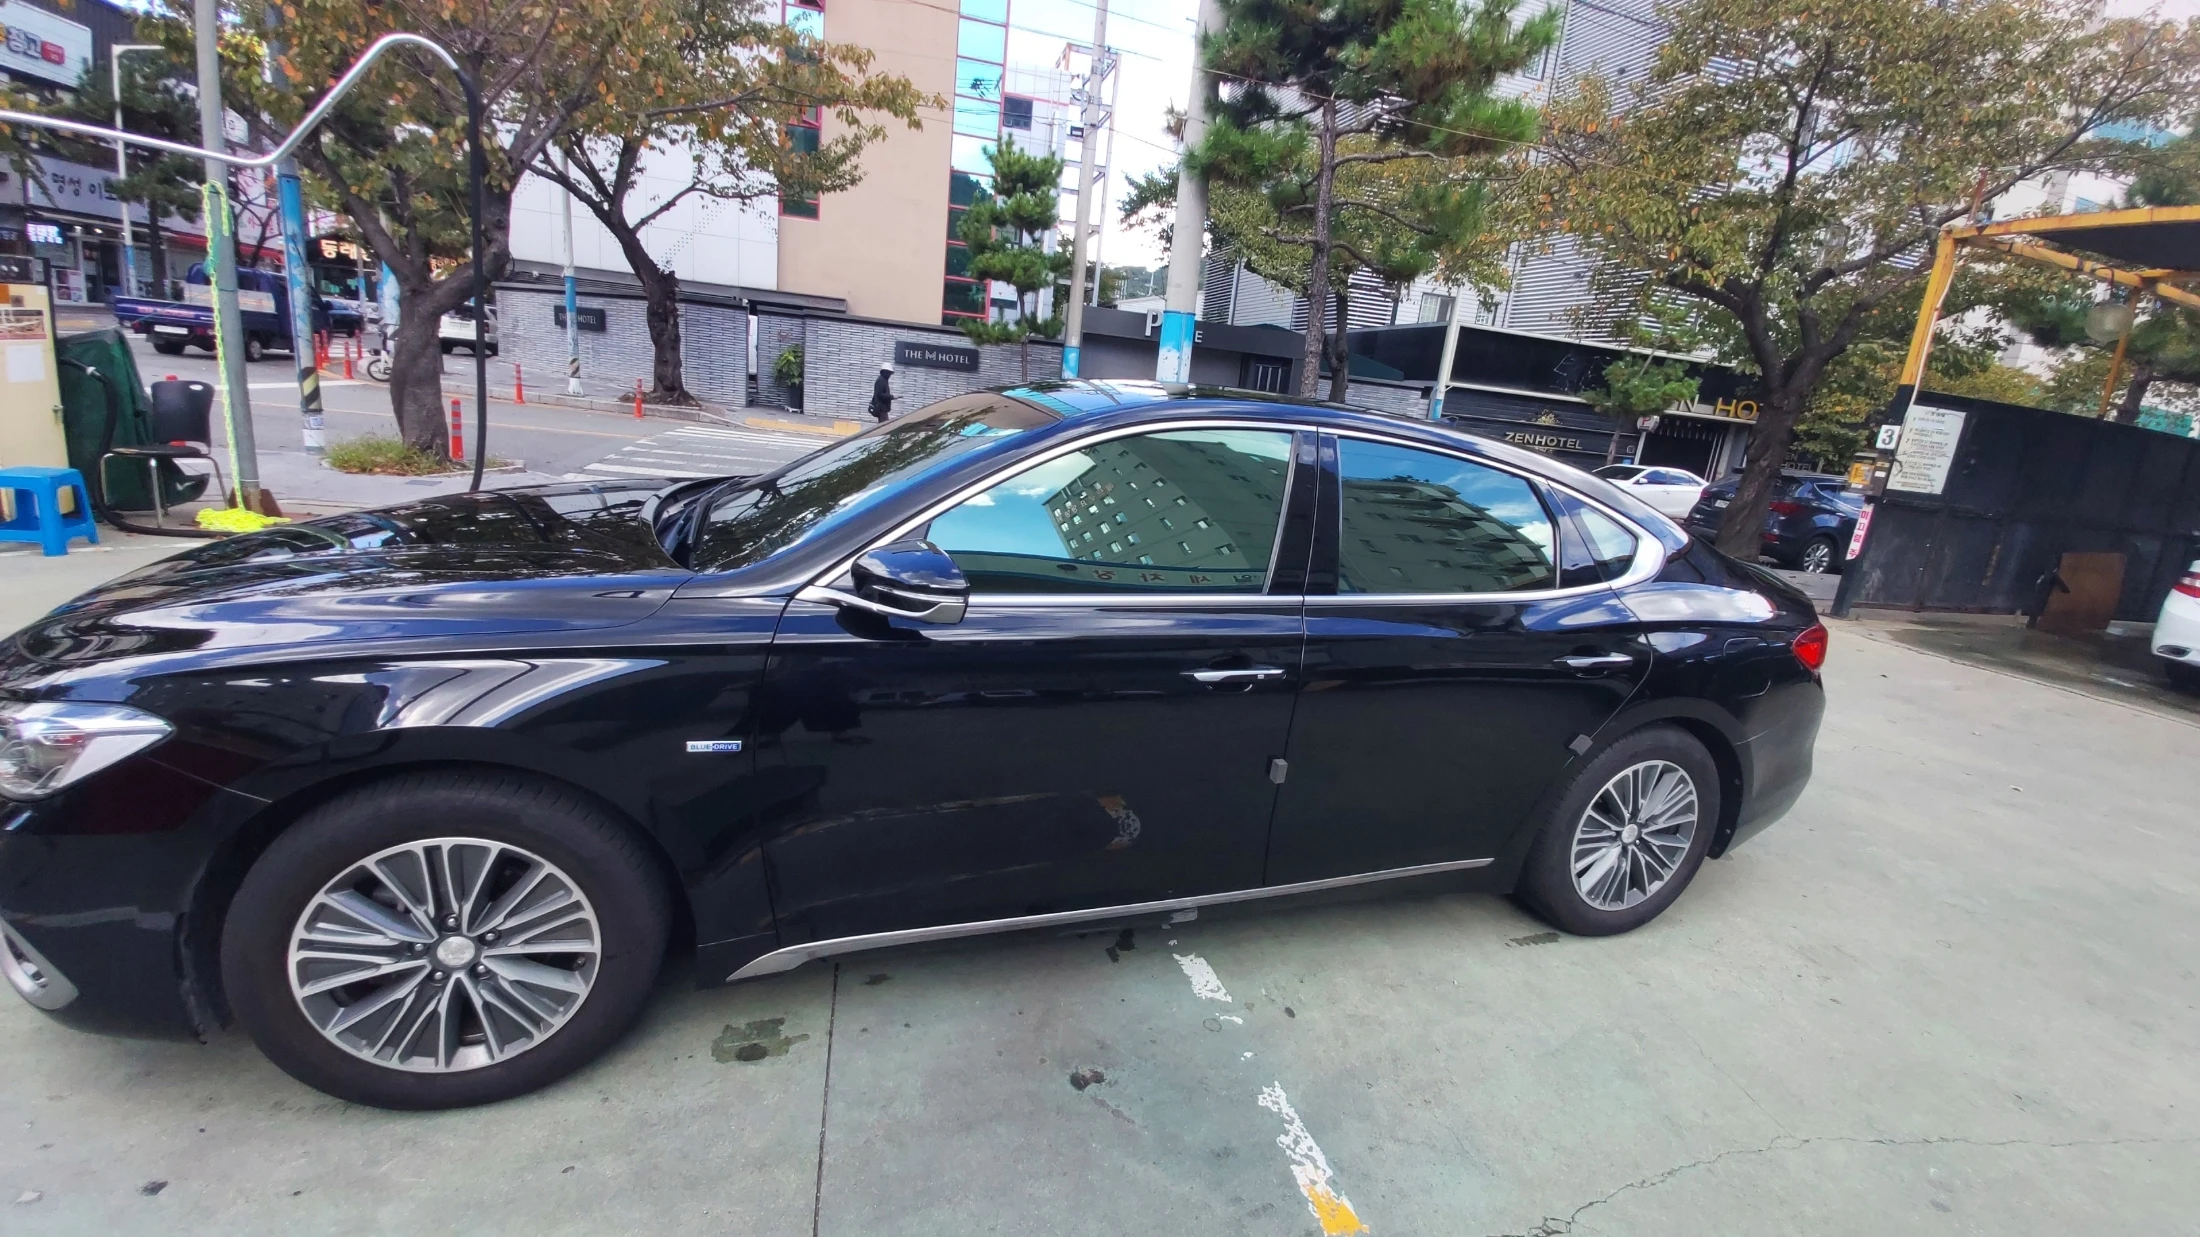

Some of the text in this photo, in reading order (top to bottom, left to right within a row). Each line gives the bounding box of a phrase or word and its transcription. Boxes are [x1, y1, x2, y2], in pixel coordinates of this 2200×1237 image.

[577, 314, 597, 325] HOTEL
[904, 349, 970, 364] THE M HOTEL
[1714, 397, 1758, 420] HO
[1881, 428, 1895, 446] 3
